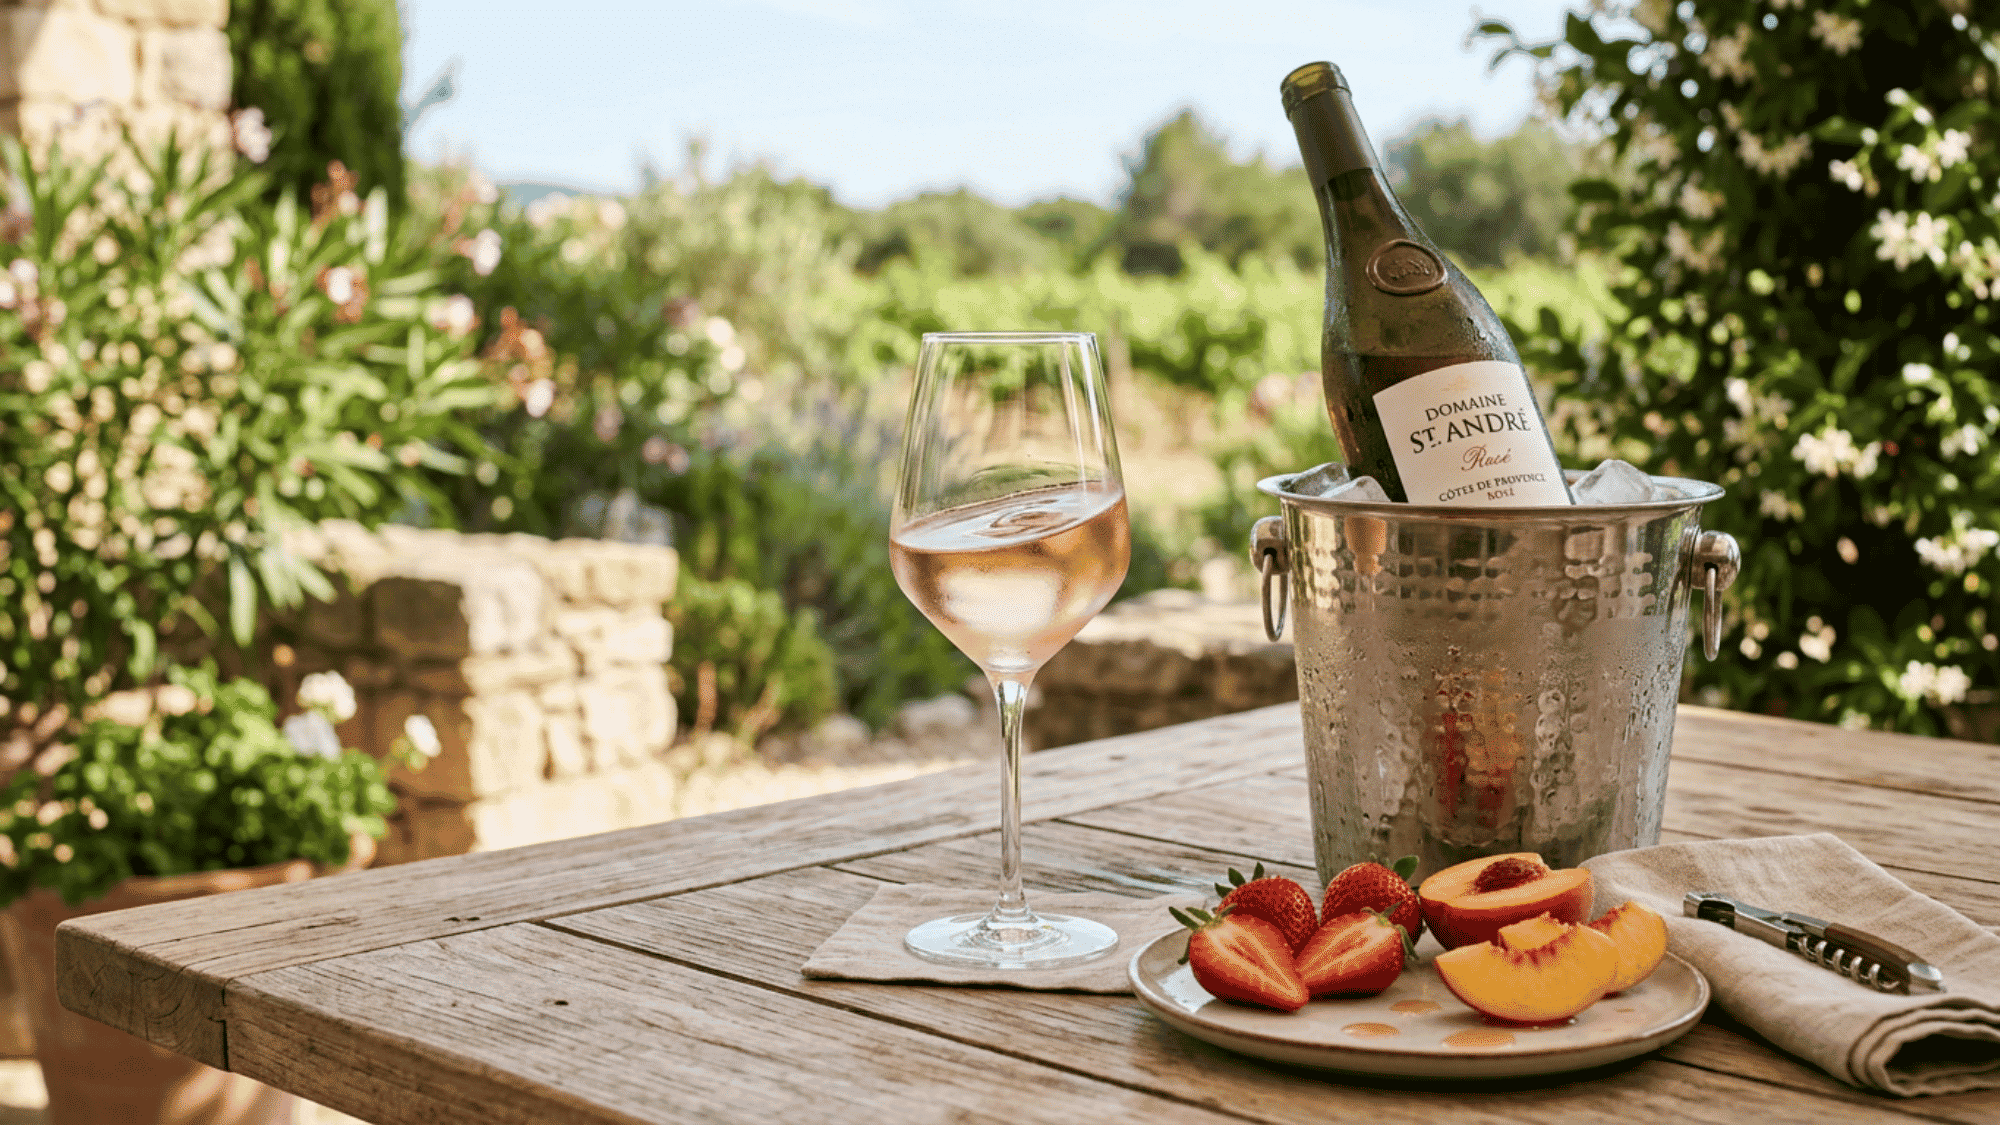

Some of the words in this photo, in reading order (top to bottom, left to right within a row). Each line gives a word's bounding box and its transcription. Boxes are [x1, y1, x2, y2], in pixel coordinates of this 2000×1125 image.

[1425, 393, 1507, 421] DOMAINE
[1447, 407, 1531, 443] ANDRÉ
[1438, 484, 1474, 502] CÔTES
[1476, 480, 1492, 491] DE
